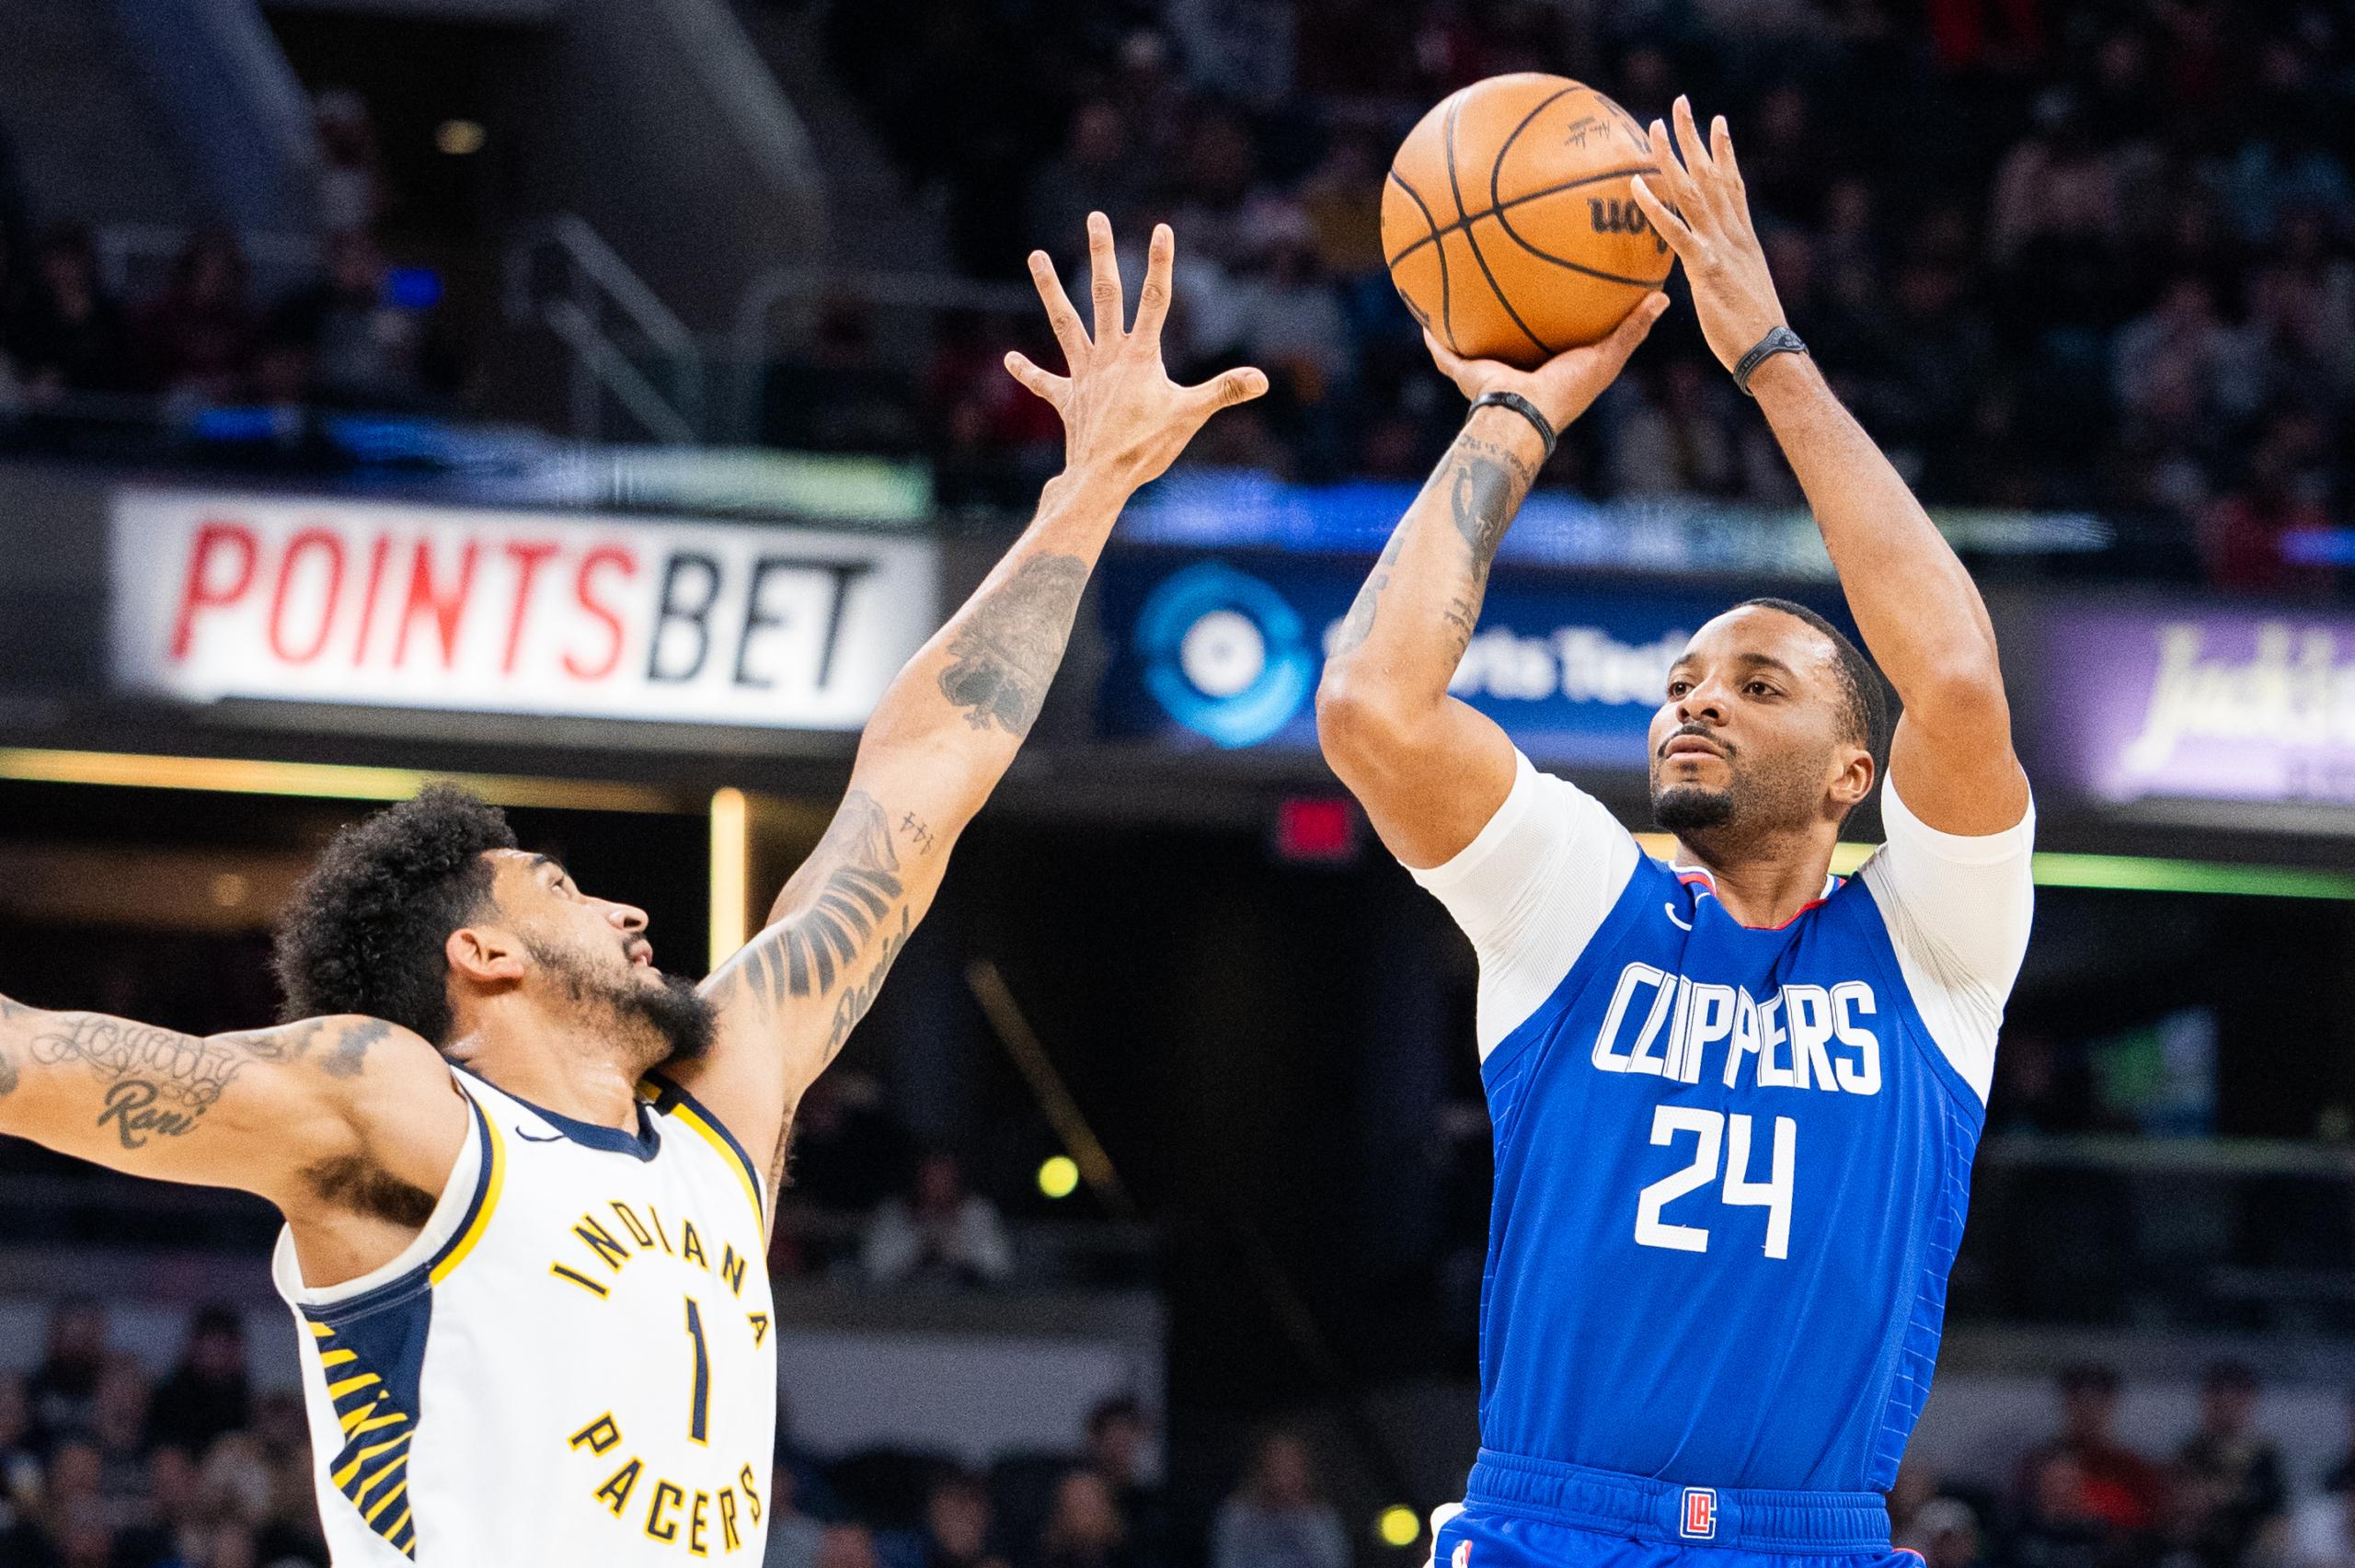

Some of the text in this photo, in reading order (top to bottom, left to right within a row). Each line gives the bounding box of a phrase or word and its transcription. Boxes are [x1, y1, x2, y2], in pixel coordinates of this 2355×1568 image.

[169, 519, 879, 691] POINTSBET
[1591, 961, 1882, 1096] CLIPPERS
[1635, 1104, 1797, 1260] 24
[549, 1199, 769, 1349] INDIANA
[684, 1291, 711, 1448] 1
[568, 1411, 762, 1558] PACERS
